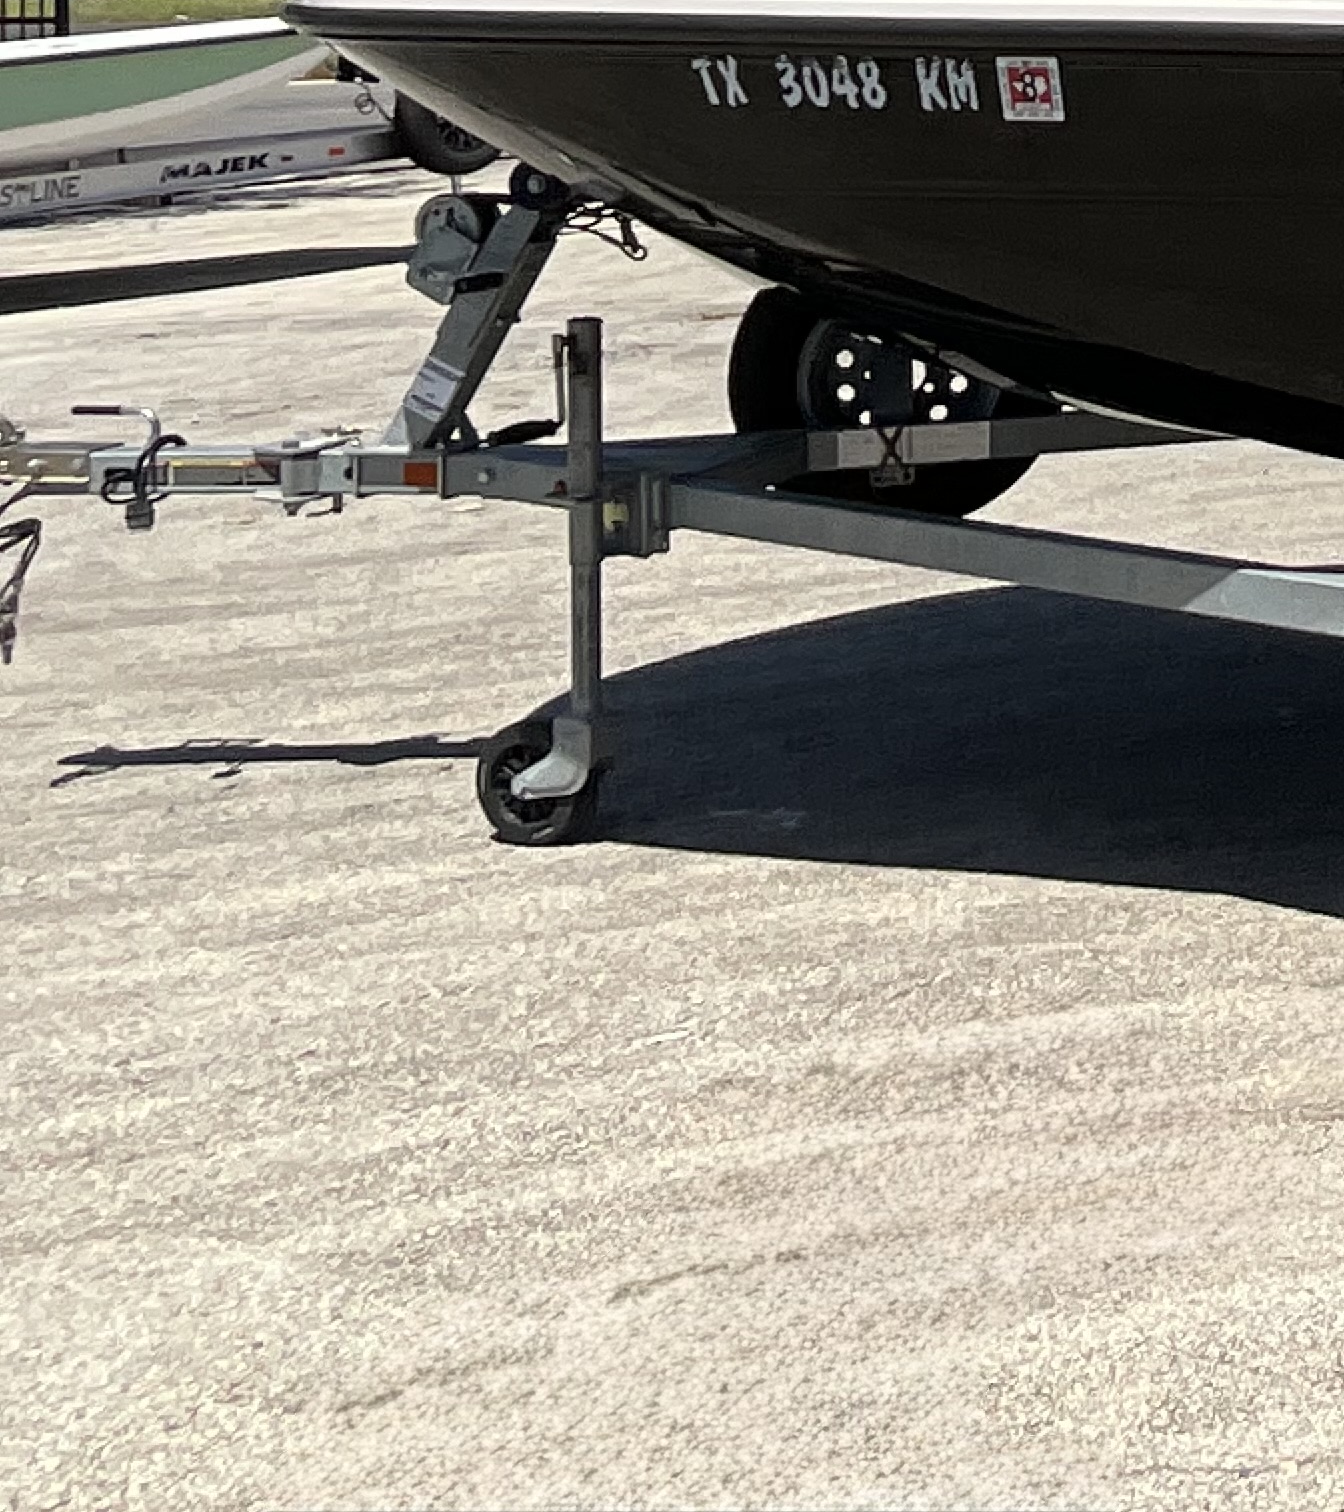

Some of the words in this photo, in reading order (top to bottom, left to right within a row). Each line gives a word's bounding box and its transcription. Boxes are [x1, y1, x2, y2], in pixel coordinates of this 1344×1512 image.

[691, 54, 749, 108] TX
[775, 54, 887, 110] 3048
[914, 56, 979, 111] KM
[159, 152, 270, 183] MAJEK
